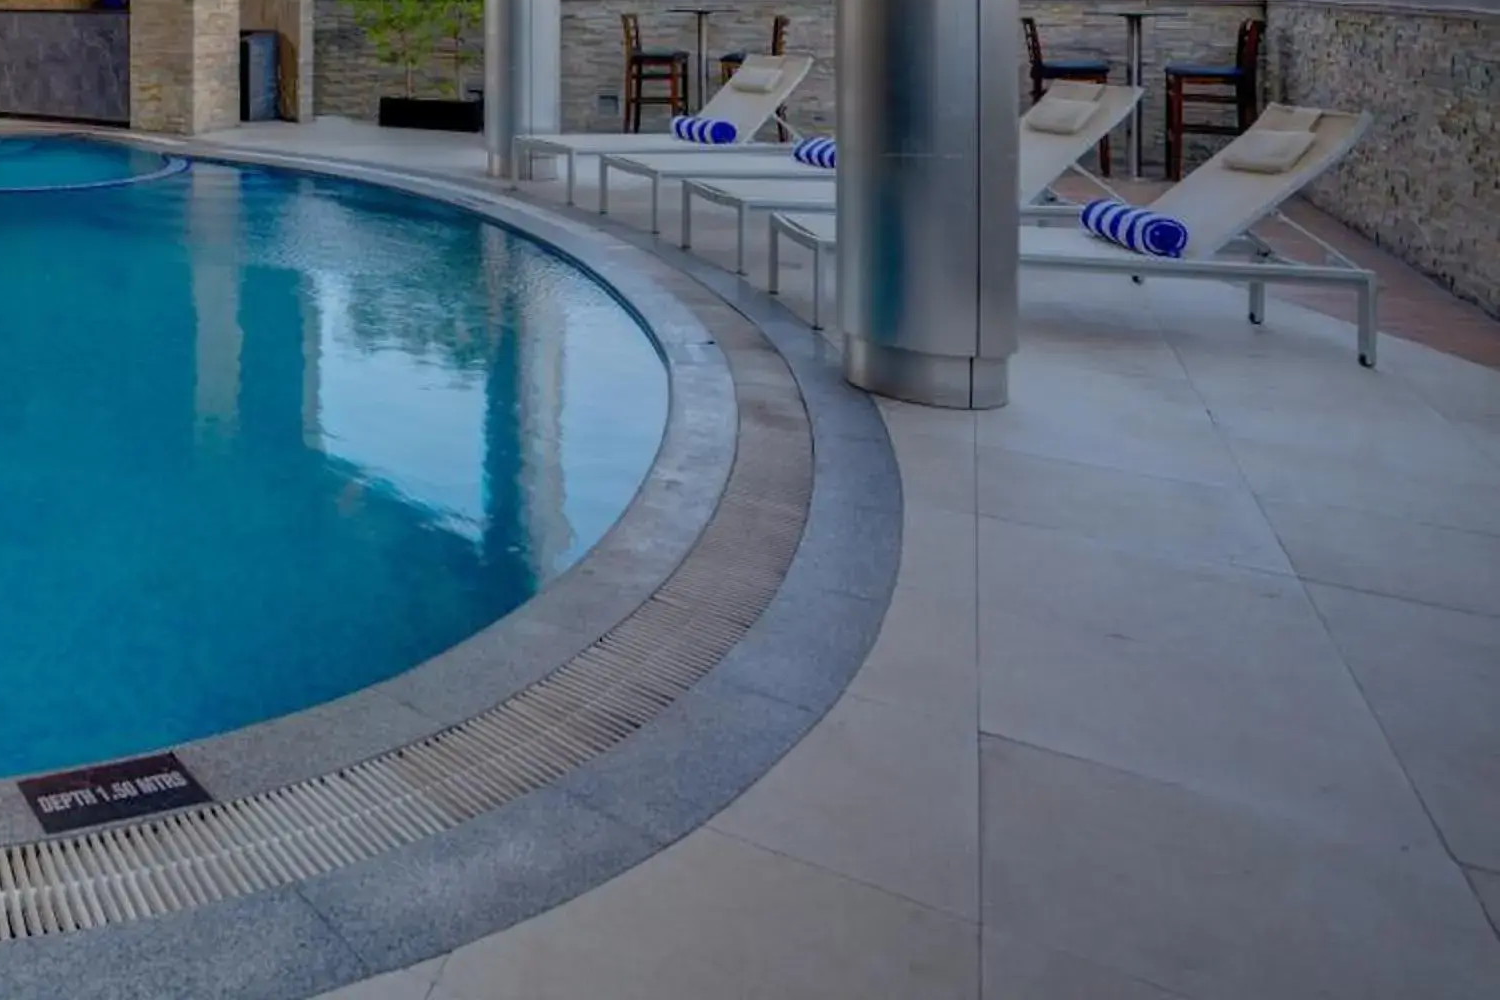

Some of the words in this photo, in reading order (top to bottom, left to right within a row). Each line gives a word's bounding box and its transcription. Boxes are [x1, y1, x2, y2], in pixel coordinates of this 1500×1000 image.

[37, 788, 97, 813] DEPTH
[96, 780, 138, 802] 1.50
[135, 770, 188, 794] MTRS
